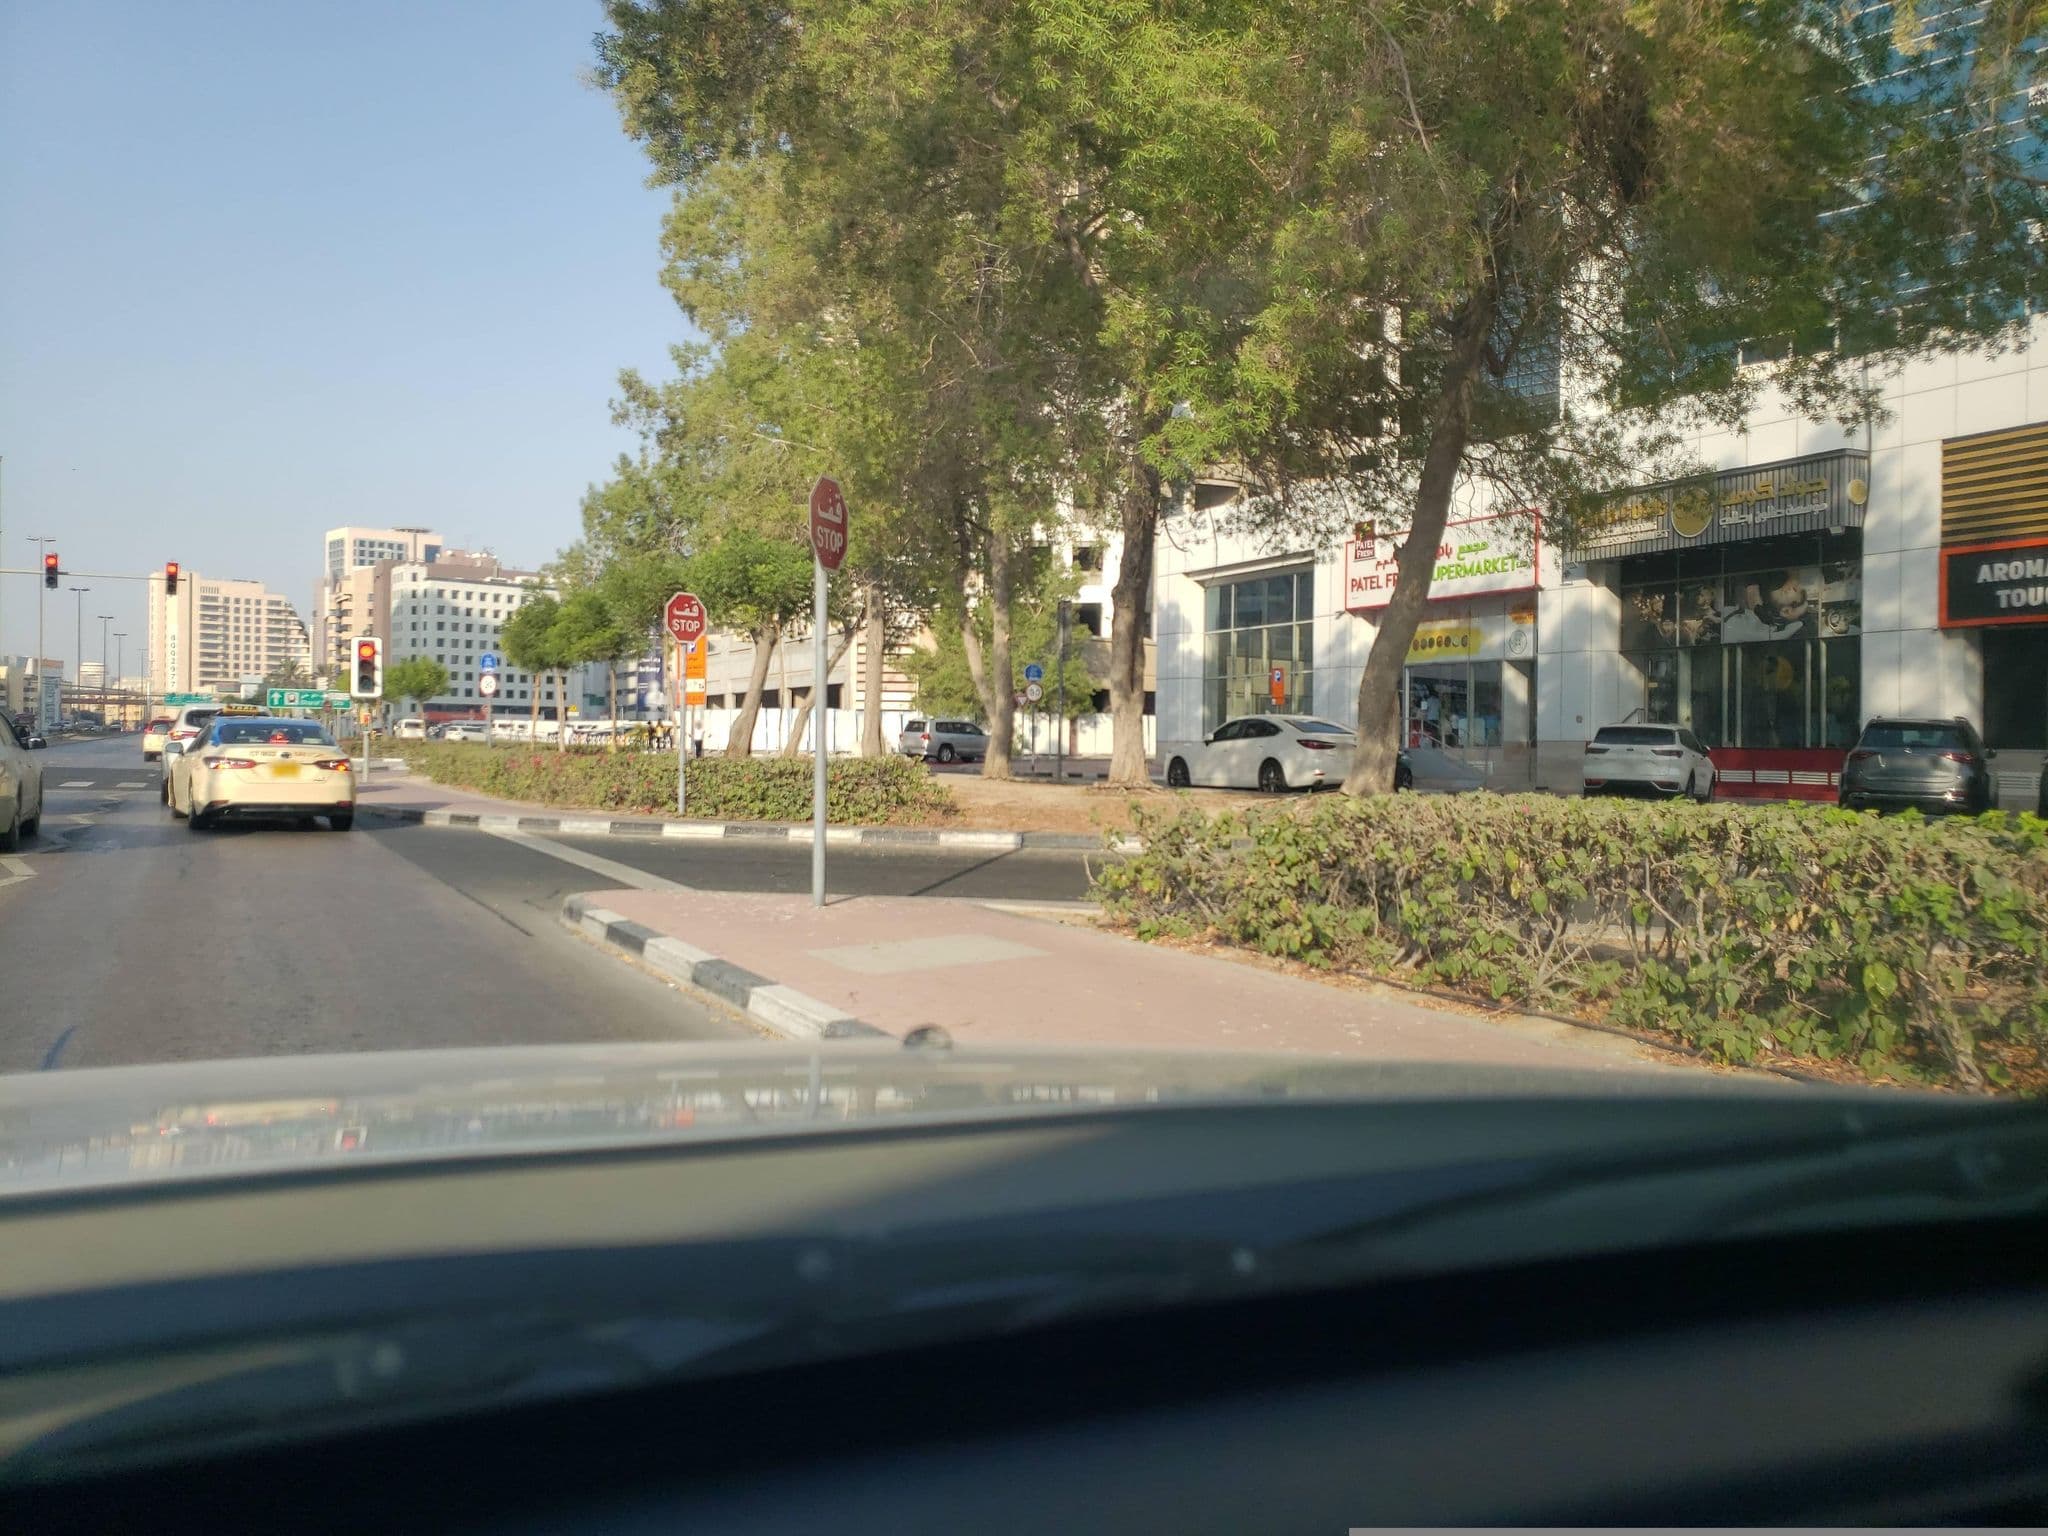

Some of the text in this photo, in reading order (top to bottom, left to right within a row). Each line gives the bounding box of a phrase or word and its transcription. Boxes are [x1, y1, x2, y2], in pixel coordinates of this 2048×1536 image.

[817, 493, 843, 525] قف
[817, 525, 843, 554] STOP
[1355, 540, 1375, 551] PATEL
[1432, 551, 1518, 581] UPERMARKET
[1977, 558, 2048, 583] AROM
[1351, 574, 1383, 593] PATEL
[1995, 586, 2048, 608] TOU
[672, 600, 699, 617] قف
[672, 618, 700, 632] STOP
